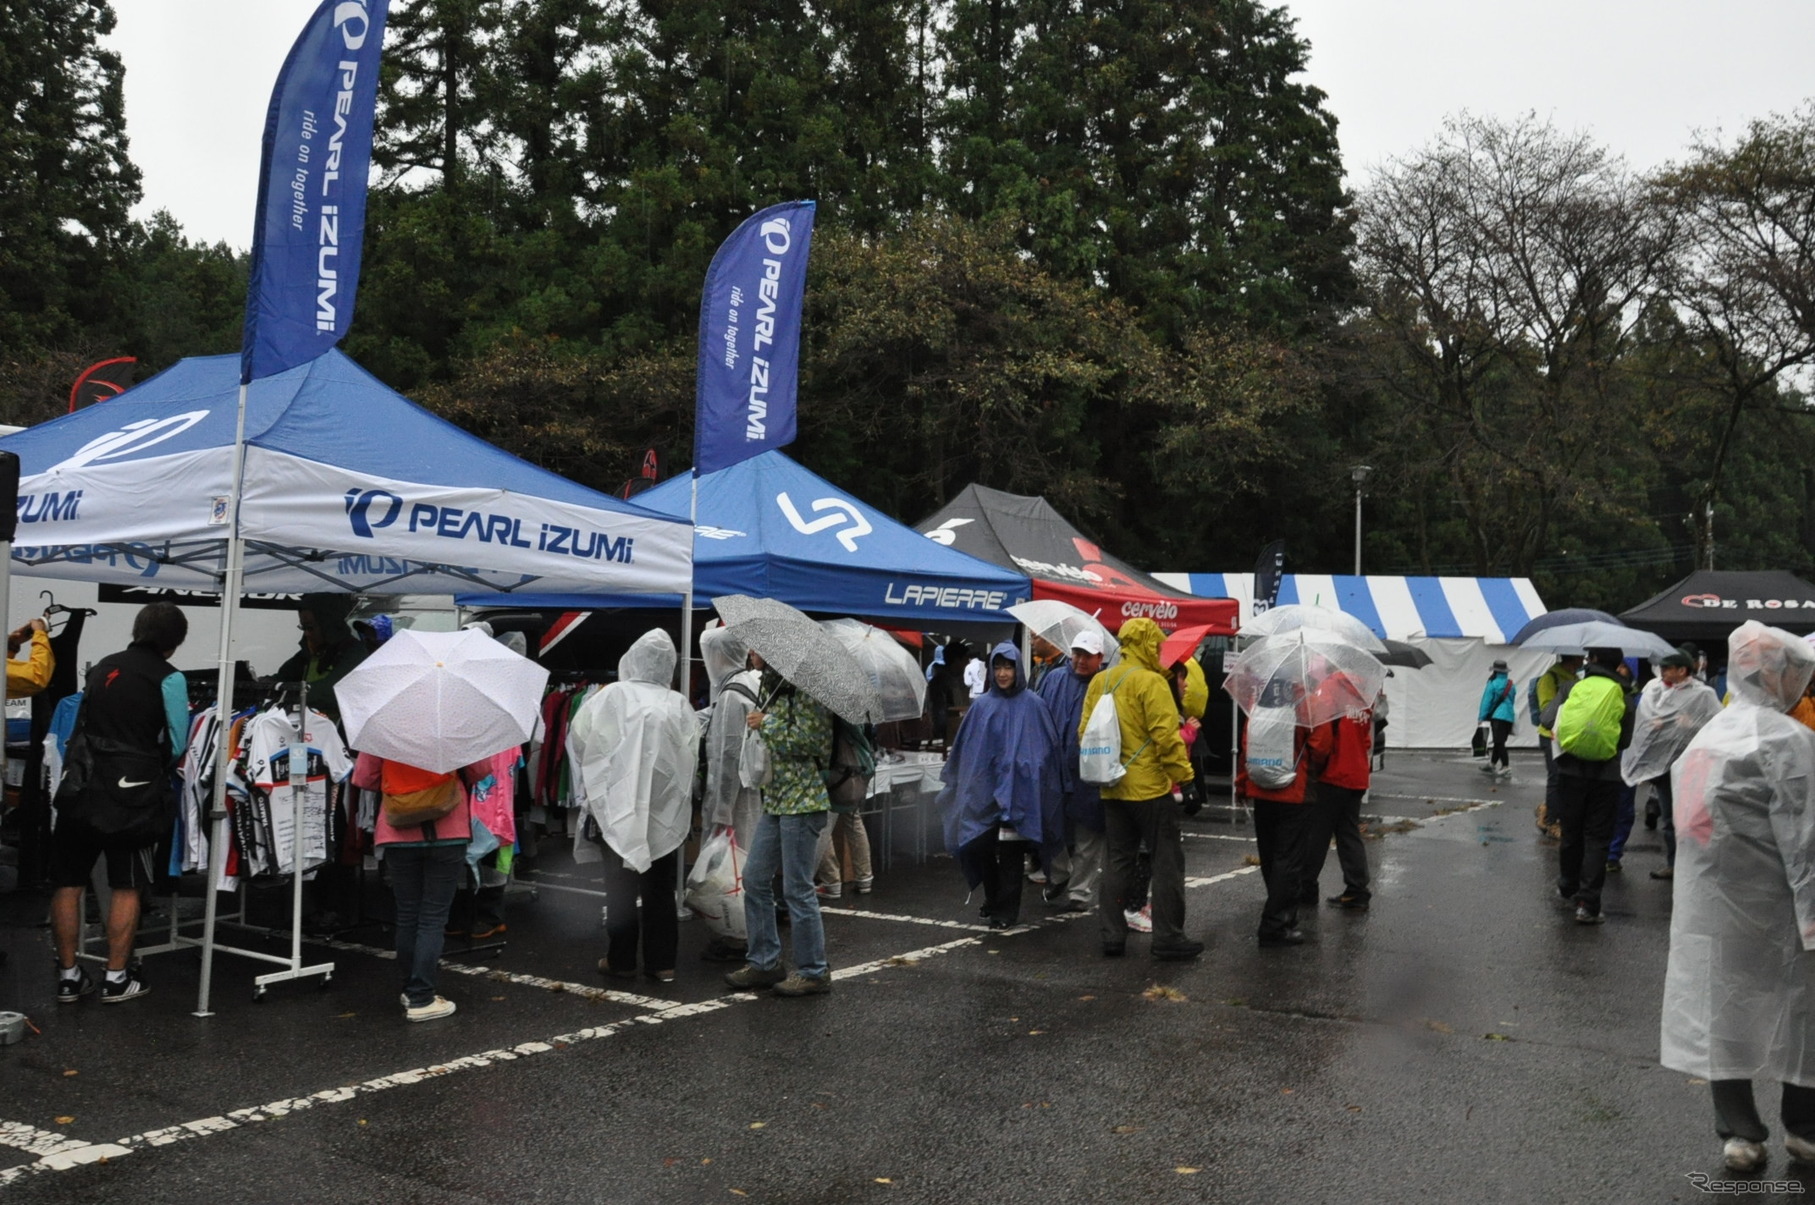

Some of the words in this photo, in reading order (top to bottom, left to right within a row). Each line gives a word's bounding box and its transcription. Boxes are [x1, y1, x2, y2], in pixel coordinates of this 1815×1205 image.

[301, 109, 318, 140] ride
[322, 60, 358, 196] PEARL
[298, 144, 310, 163] on
[291, 167, 308, 231] together
[730, 285, 744, 307] ride
[753, 258, 782, 351] PEARL
[728, 310, 738, 322] on
[723, 324, 739, 369] together
[409, 503, 532, 549] PEARL
[884, 582, 1005, 610] LAPIERRE
[1703, 599, 1738, 609] DE
[1746, 599, 1815, 609] ROSA
